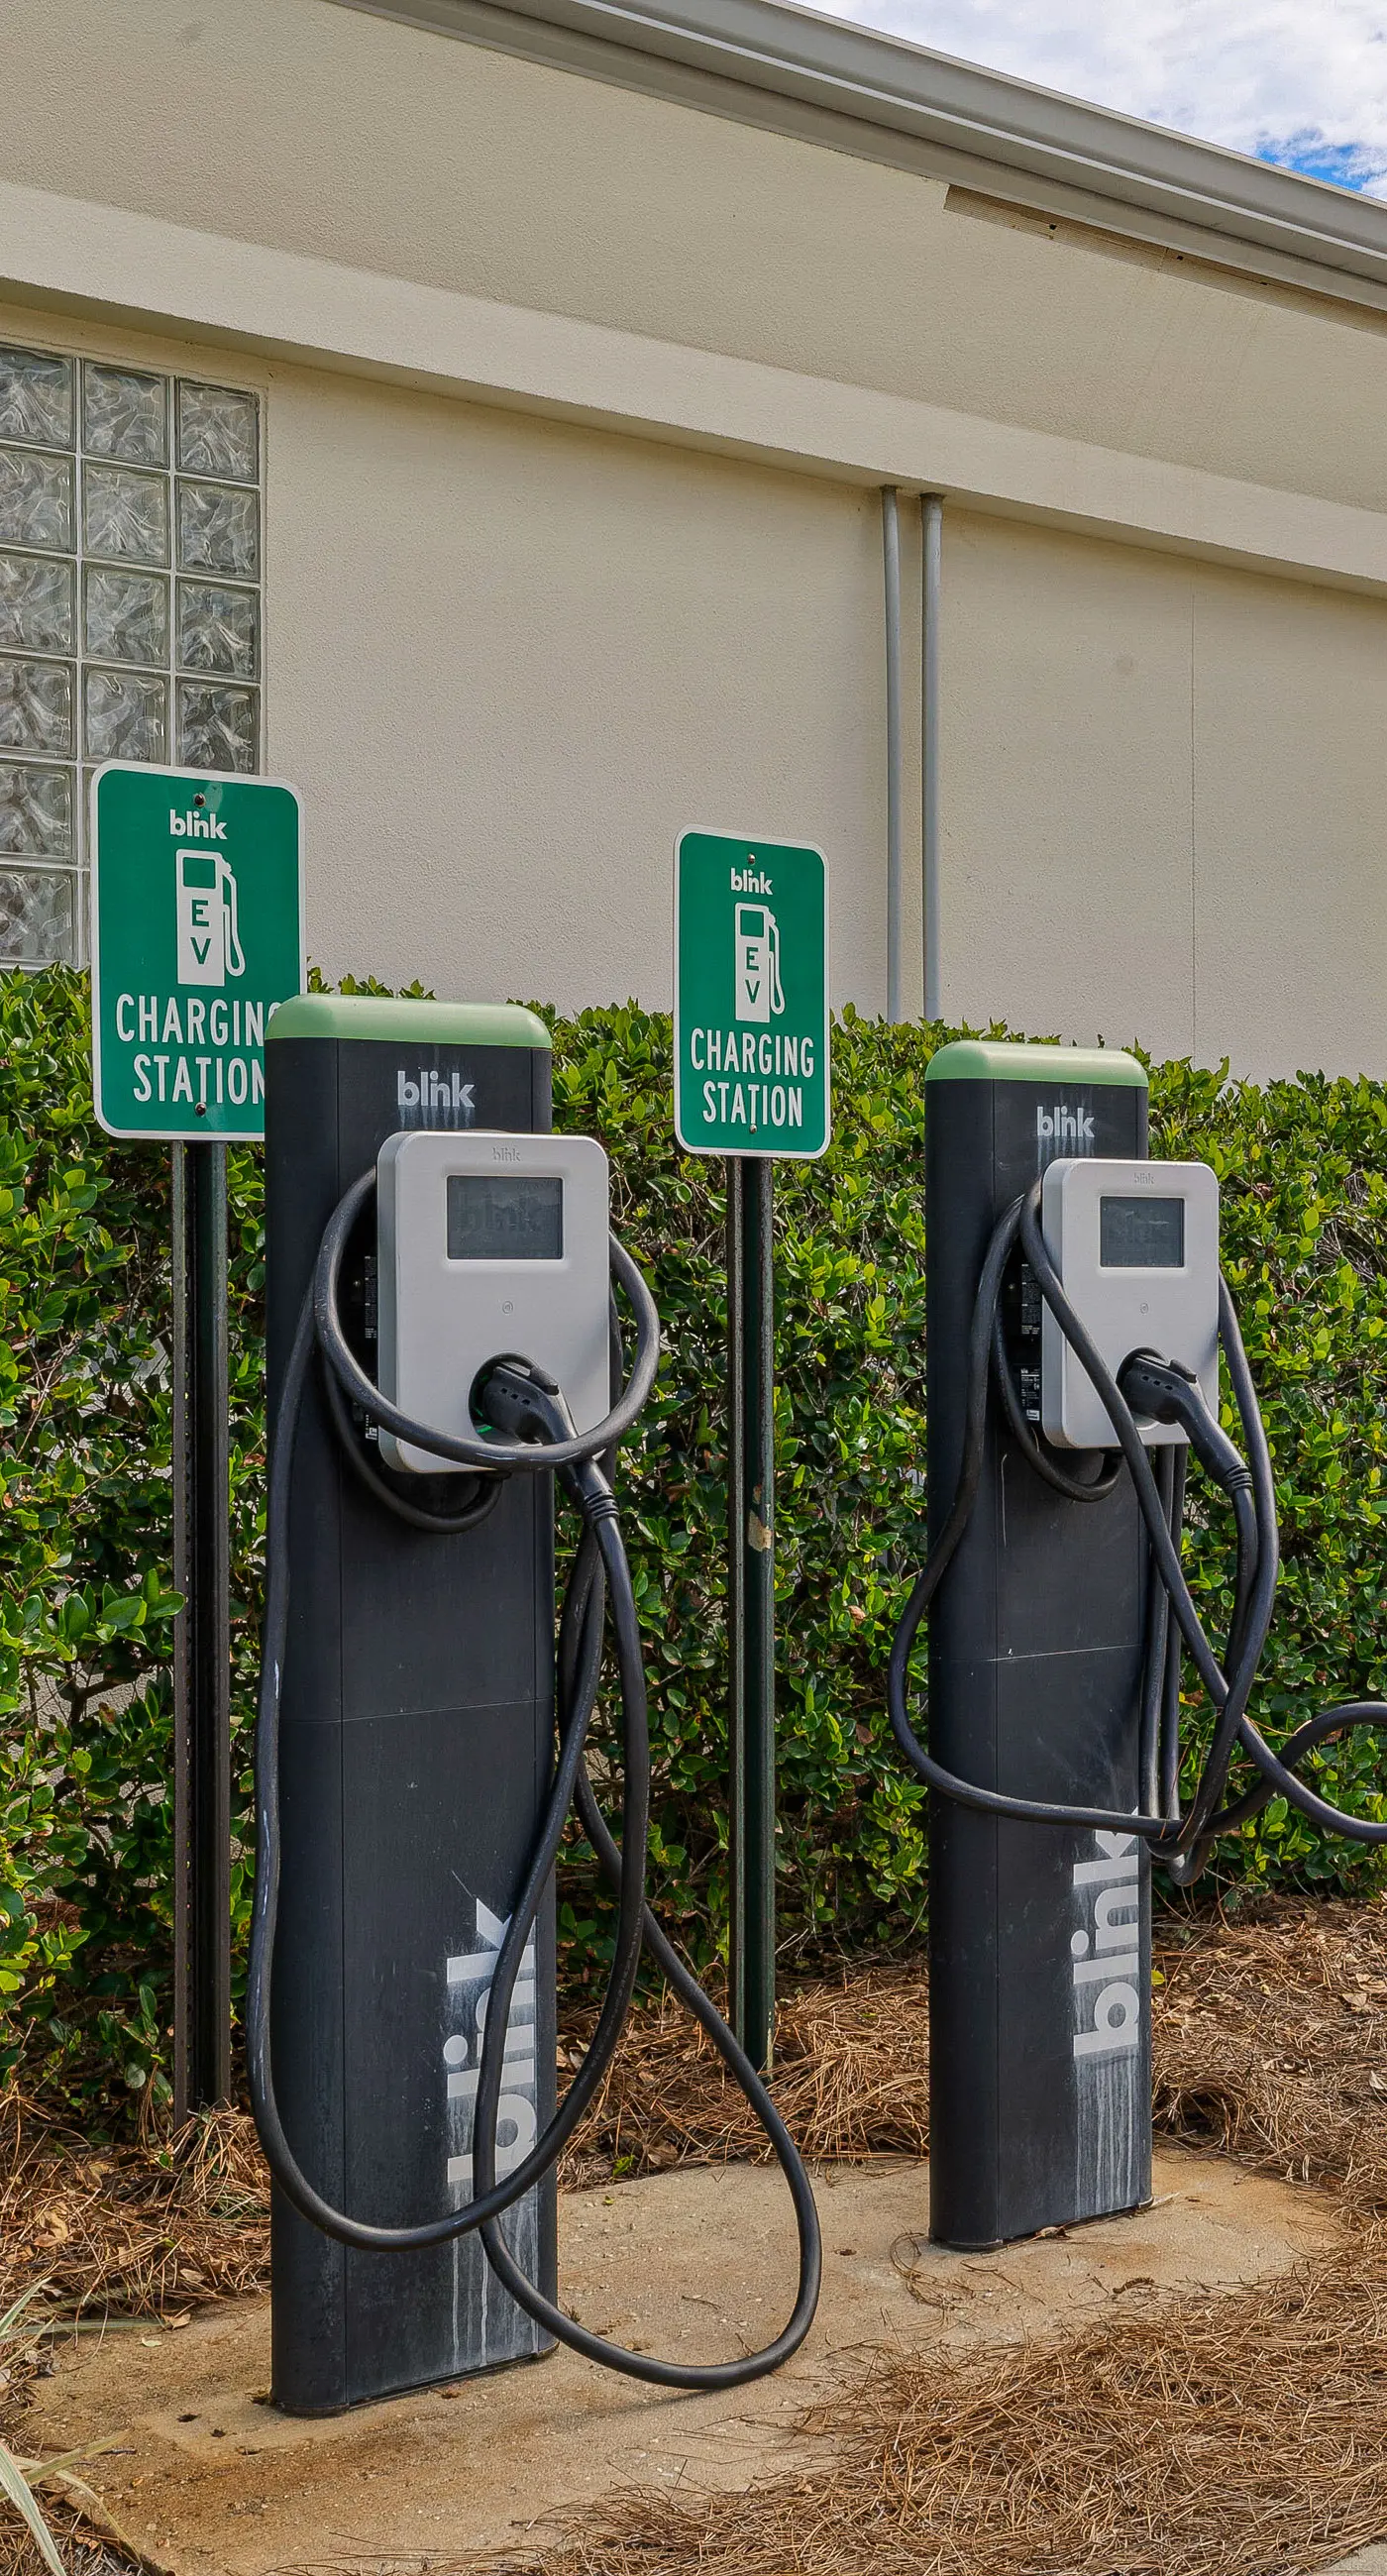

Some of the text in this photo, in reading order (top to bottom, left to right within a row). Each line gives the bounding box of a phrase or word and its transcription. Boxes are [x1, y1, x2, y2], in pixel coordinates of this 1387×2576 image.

[169, 809, 228, 839] blink
[730, 867, 773, 895] blink
[116, 994, 281, 1046] CHARGIN
[691, 1027, 814, 1078] CHARGING
[397, 1070, 475, 1108] blink
[702, 1080, 802, 1127] STATION
[1036, 1106, 1095, 1137] blink
[1070, 1805, 1138, 2057] blink
